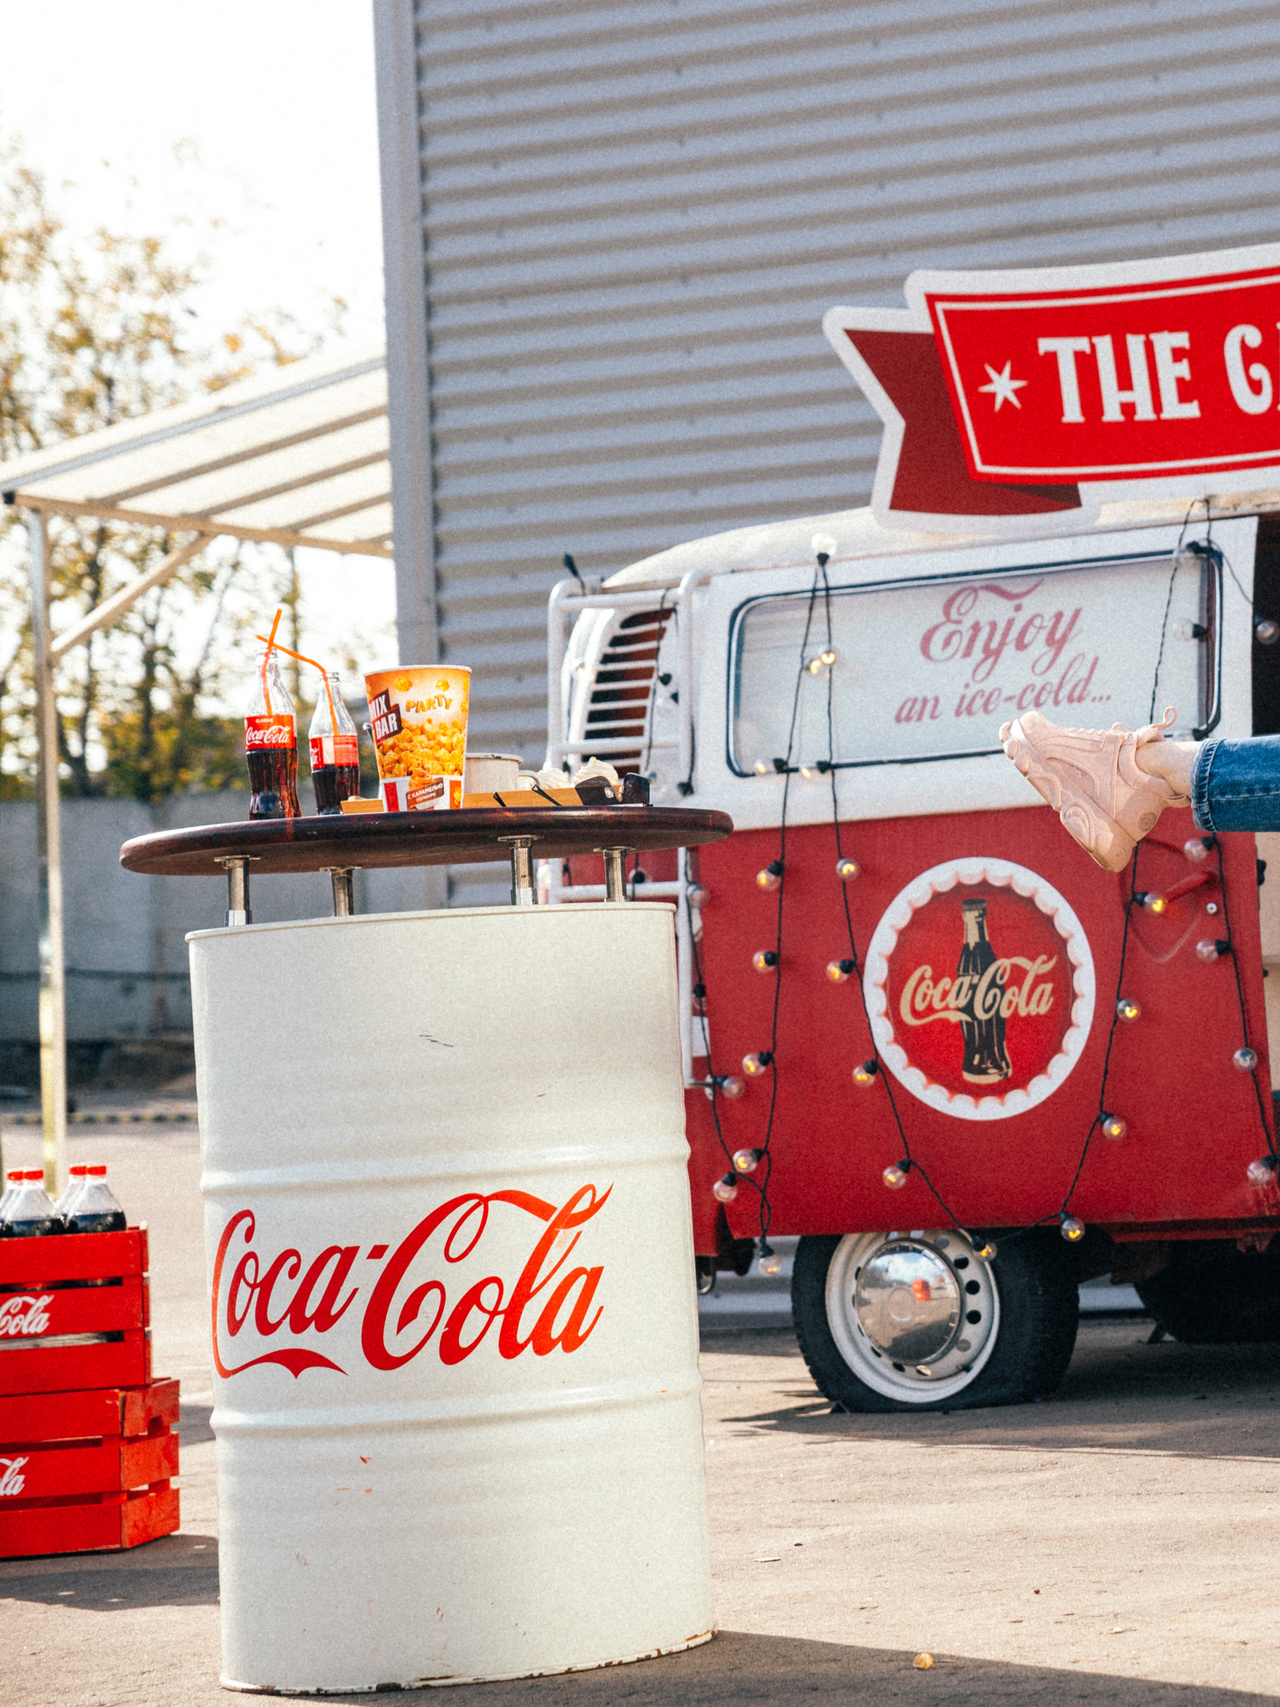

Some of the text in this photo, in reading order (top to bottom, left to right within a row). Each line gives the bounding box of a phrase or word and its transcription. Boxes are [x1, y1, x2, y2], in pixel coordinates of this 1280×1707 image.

[1039, 330, 1200, 425] THE
[920, 578, 1083, 683] Enjoy
[369, 694, 388, 719] MIX
[405, 694, 453, 713] PARTY
[895, 654, 1111, 724] an ice-cold...
[246, 725, 291, 745] Coca-Cola
[375, 712, 399, 740] BAR
[900, 955, 1057, 1025] Coca-Cola
[212, 1182, 615, 1379] Coca-Cola
